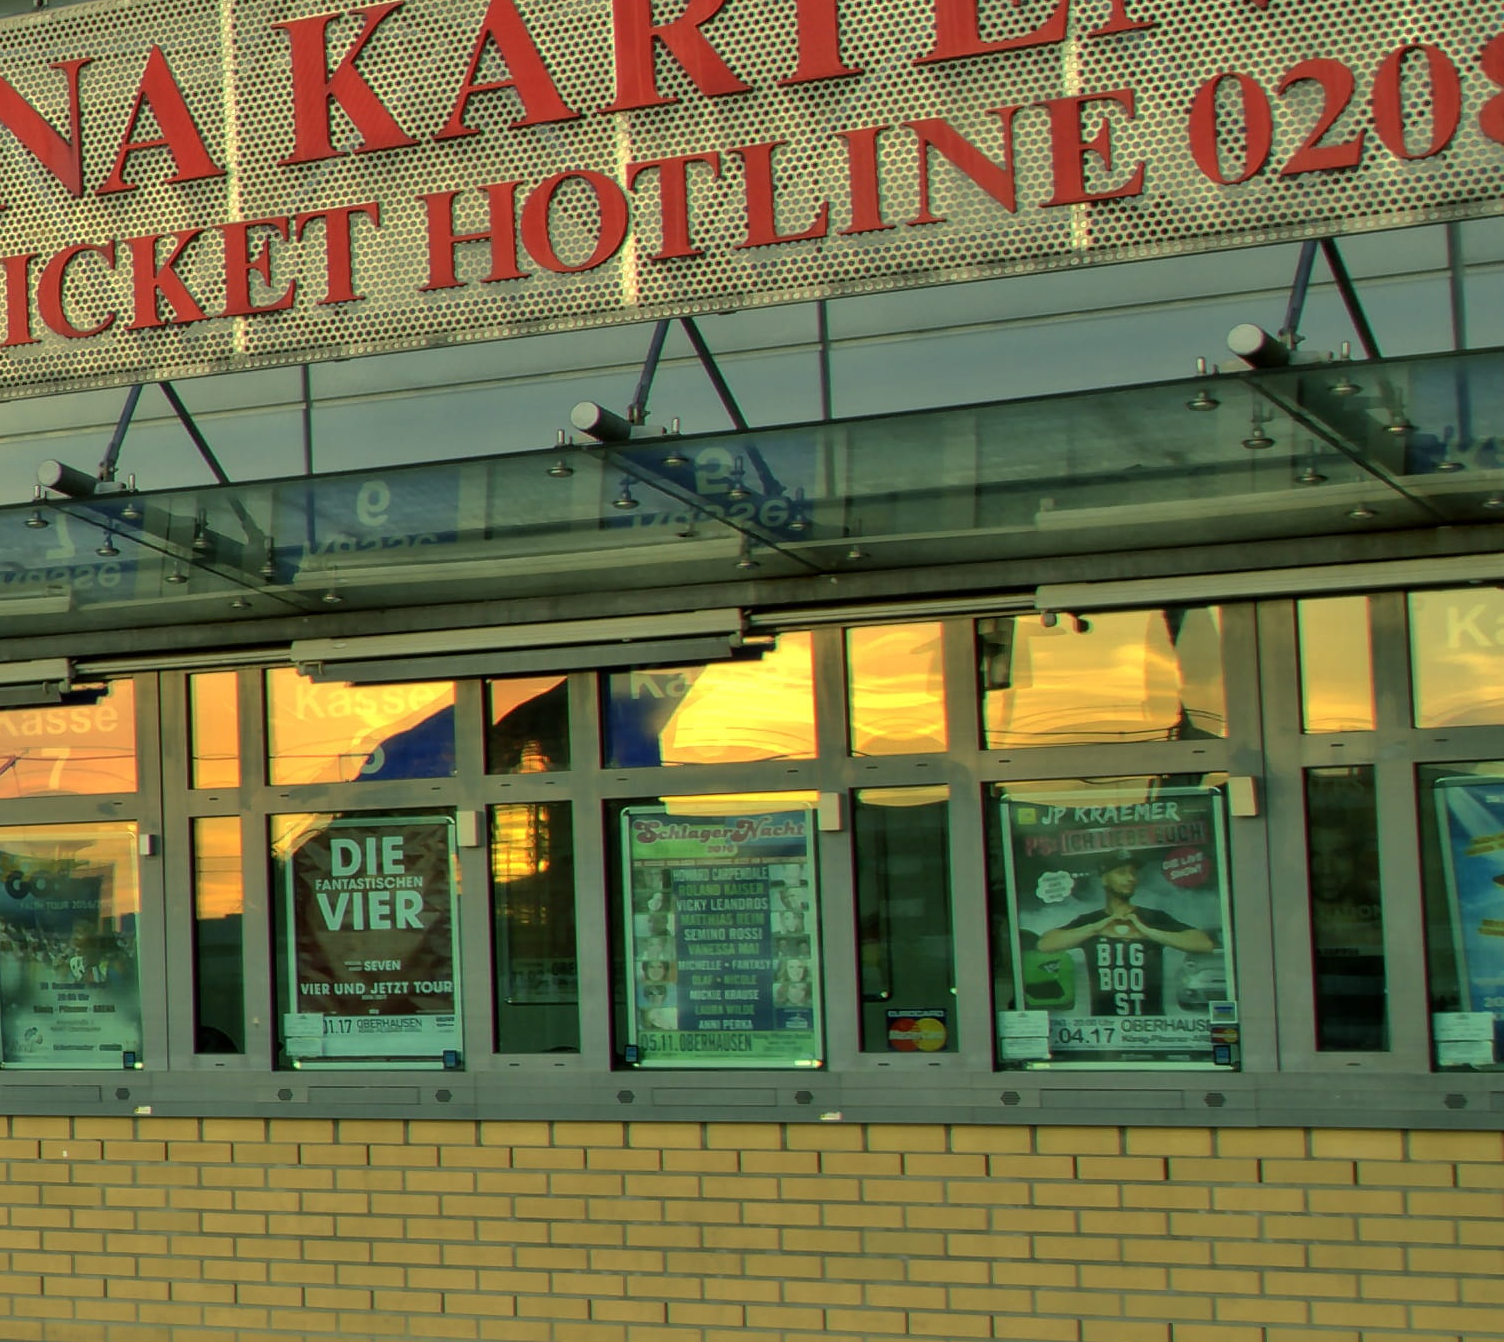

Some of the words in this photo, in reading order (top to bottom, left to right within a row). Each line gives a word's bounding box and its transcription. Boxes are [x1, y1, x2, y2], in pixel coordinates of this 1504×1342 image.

[417, 87, 1146, 293] HOTLINE
[294, 682, 434, 720] Kasse
[40, 747, 72, 790] 7
[1042, 807, 1067, 825] JP
[1074, 802, 1181, 824] KRAEMER
[1064, 831, 1095, 853] ICH
[1100, 827, 1146, 850] LIEBE
[1156, 822, 1206, 845] EUCH
[331, 836, 405, 877] DIE
[315, 876, 423, 891] FANTASTISCHEN
[678, 884, 721, 896] ROLAND
[724, 883, 764, 895] KAISER
[317, 890, 424, 931] VIER
[676, 899, 707, 911] VICKY
[710, 898, 768, 910] LEANDROS
[684, 929, 725, 940] SEMINO
[729, 928, 763, 940] ROSSI
[688, 943, 736, 956] VANESSA
[738, 943, 760, 955] MAI
[1096, 943, 1144, 966] BIG
[364, 960, 401, 971] SEVEN
[732, 960, 771, 970] FANTASY
[300, 983, 330, 995] VIER
[334, 983, 366, 995] UND
[371, 981, 408, 994] JETZT
[413, 981, 453, 993] TOUR
[1099, 968, 1144, 991] BOO
[724, 990, 759, 1000] KRAUSE
[1115, 993, 1146, 1016] ST
[357, 1019, 422, 1029] OBERHAUSEN
